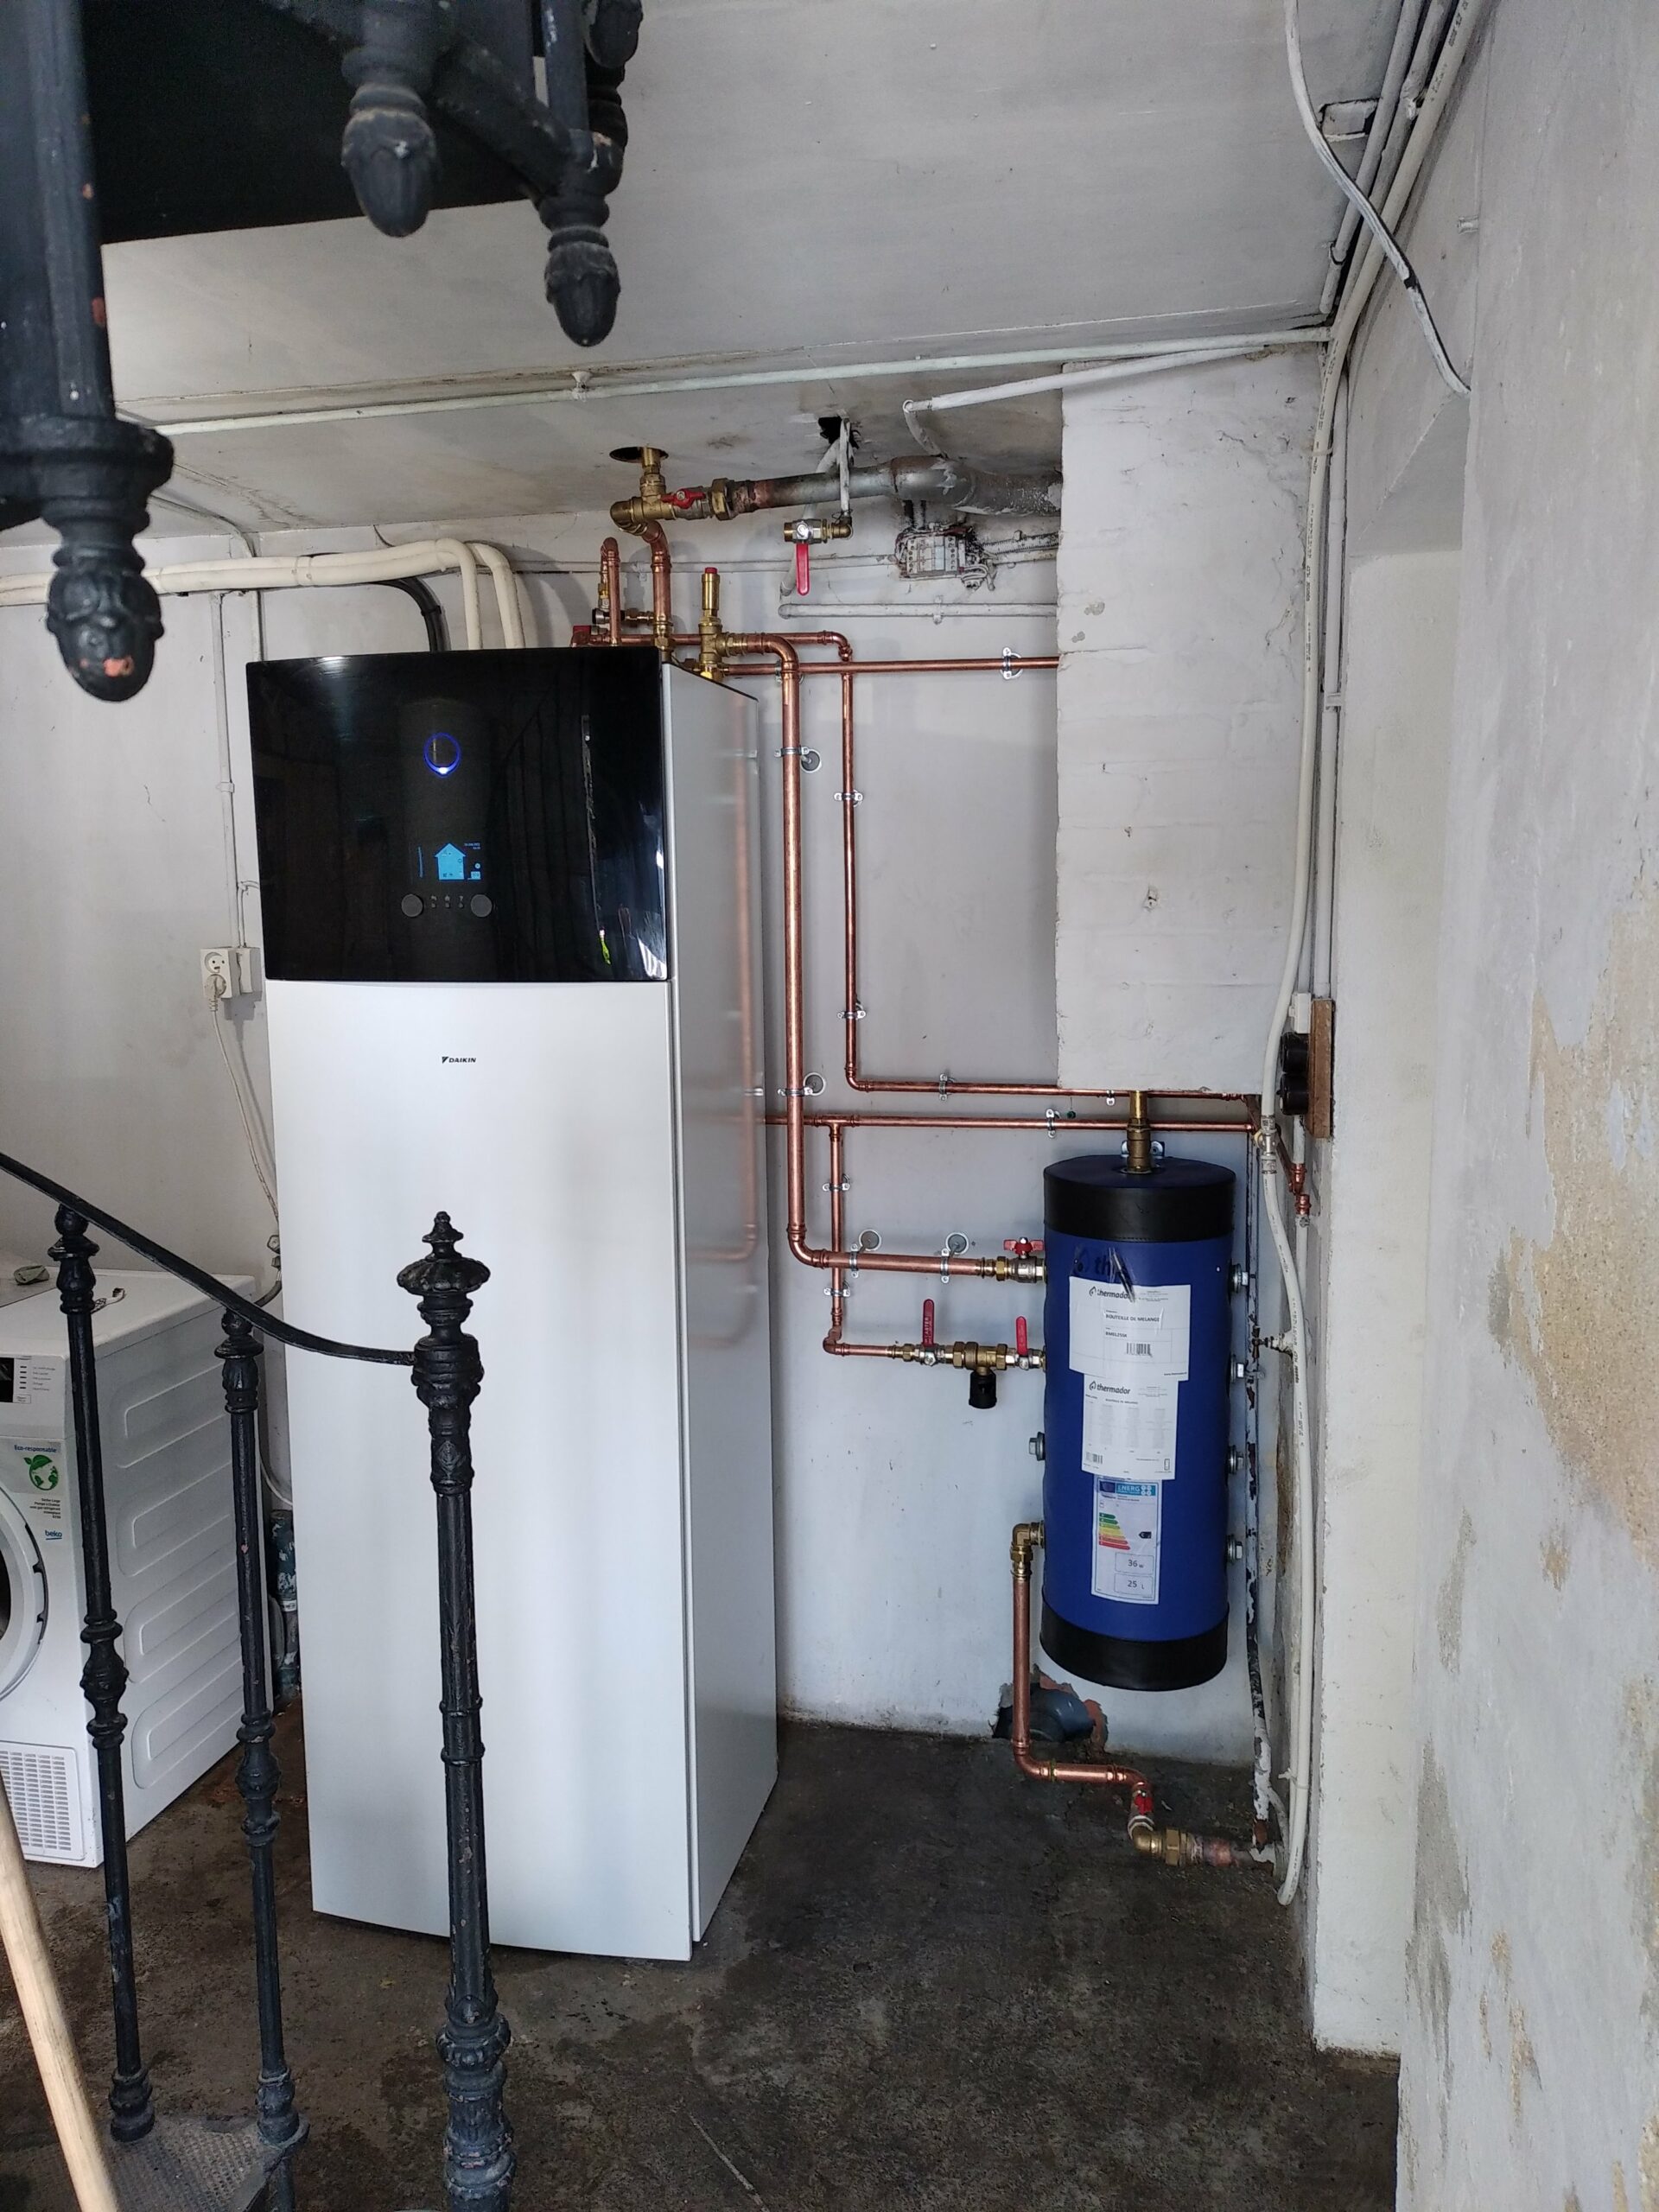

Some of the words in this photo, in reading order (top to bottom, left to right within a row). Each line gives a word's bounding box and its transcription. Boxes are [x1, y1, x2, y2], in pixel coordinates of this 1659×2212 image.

[1097, 1383, 1131, 1395] thermador
[14, 1444, 57, 1453] Eco-responsable
[45, 1529, 63, 1538] beko
[1128, 1559, 1138, 1567] 36
